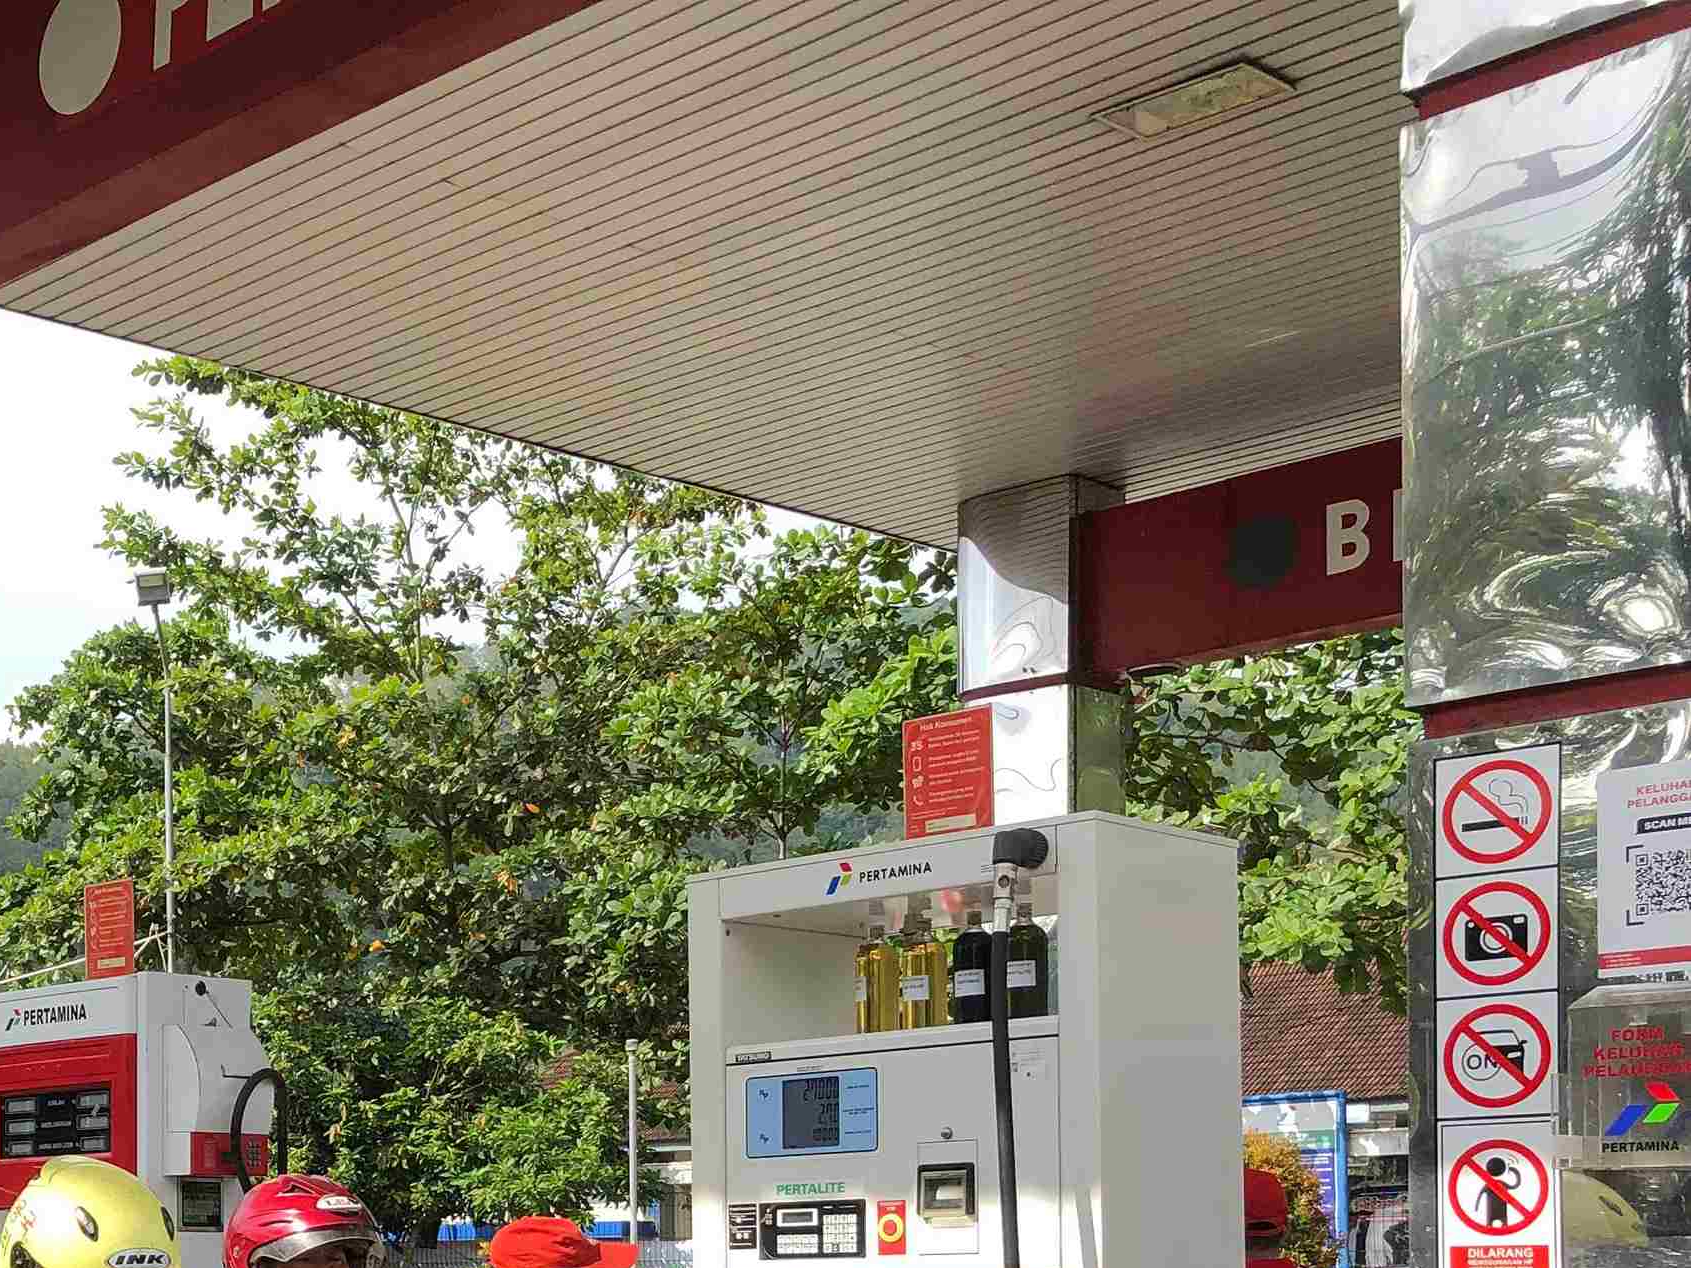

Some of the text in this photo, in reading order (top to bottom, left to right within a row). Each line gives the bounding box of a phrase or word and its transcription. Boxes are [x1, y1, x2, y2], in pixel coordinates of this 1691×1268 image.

[1626, 792, 1691, 808] PELANGG
[1644, 818, 1677, 831] SCAN
[859, 862, 932, 882] PERTAMINA
[23, 1003, 86, 1026] PERTAMINA
[1602, 1141, 1680, 1153] PERTAMINA
[775, 1182, 845, 1196] PERTALITE
[1467, 1247, 1533, 1258] DILARANG
[115, 1254, 166, 1265] INK
